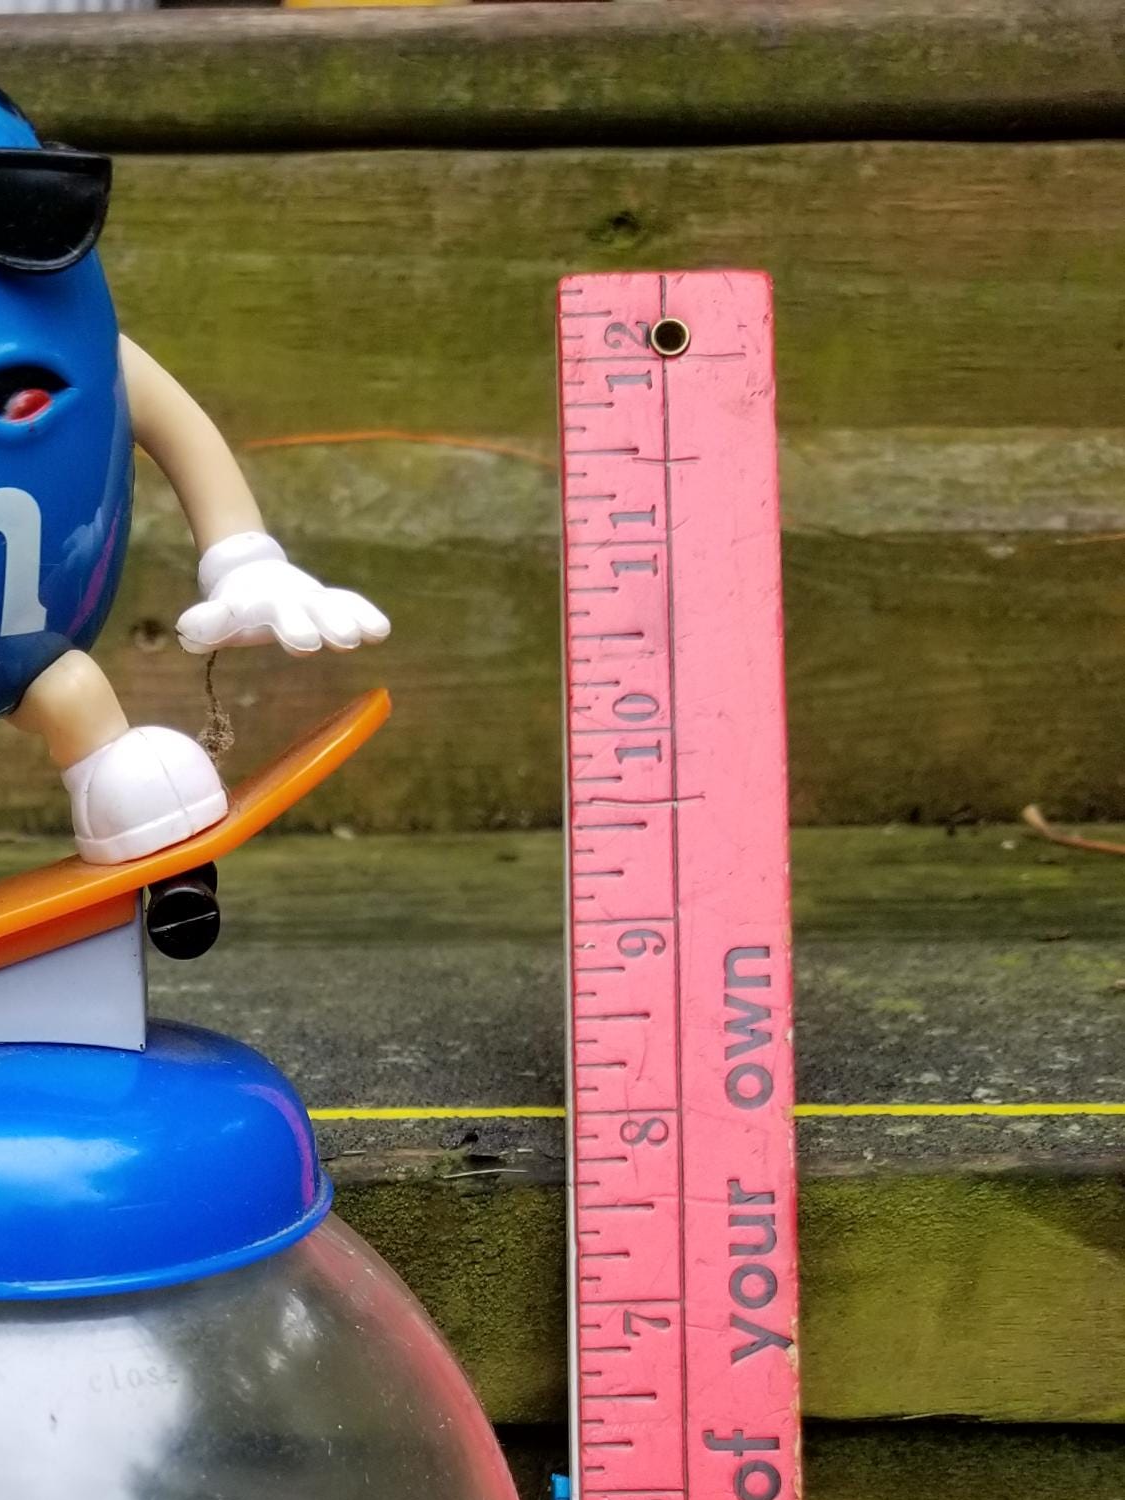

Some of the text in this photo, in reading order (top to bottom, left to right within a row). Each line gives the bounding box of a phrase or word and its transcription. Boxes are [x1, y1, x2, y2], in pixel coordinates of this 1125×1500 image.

[617, 928, 666, 958] 9
[724, 944, 774, 1110] own
[620, 1118, 669, 1147] 8
[727, 1178, 794, 1365] your
[623, 1310, 671, 1338] 7
